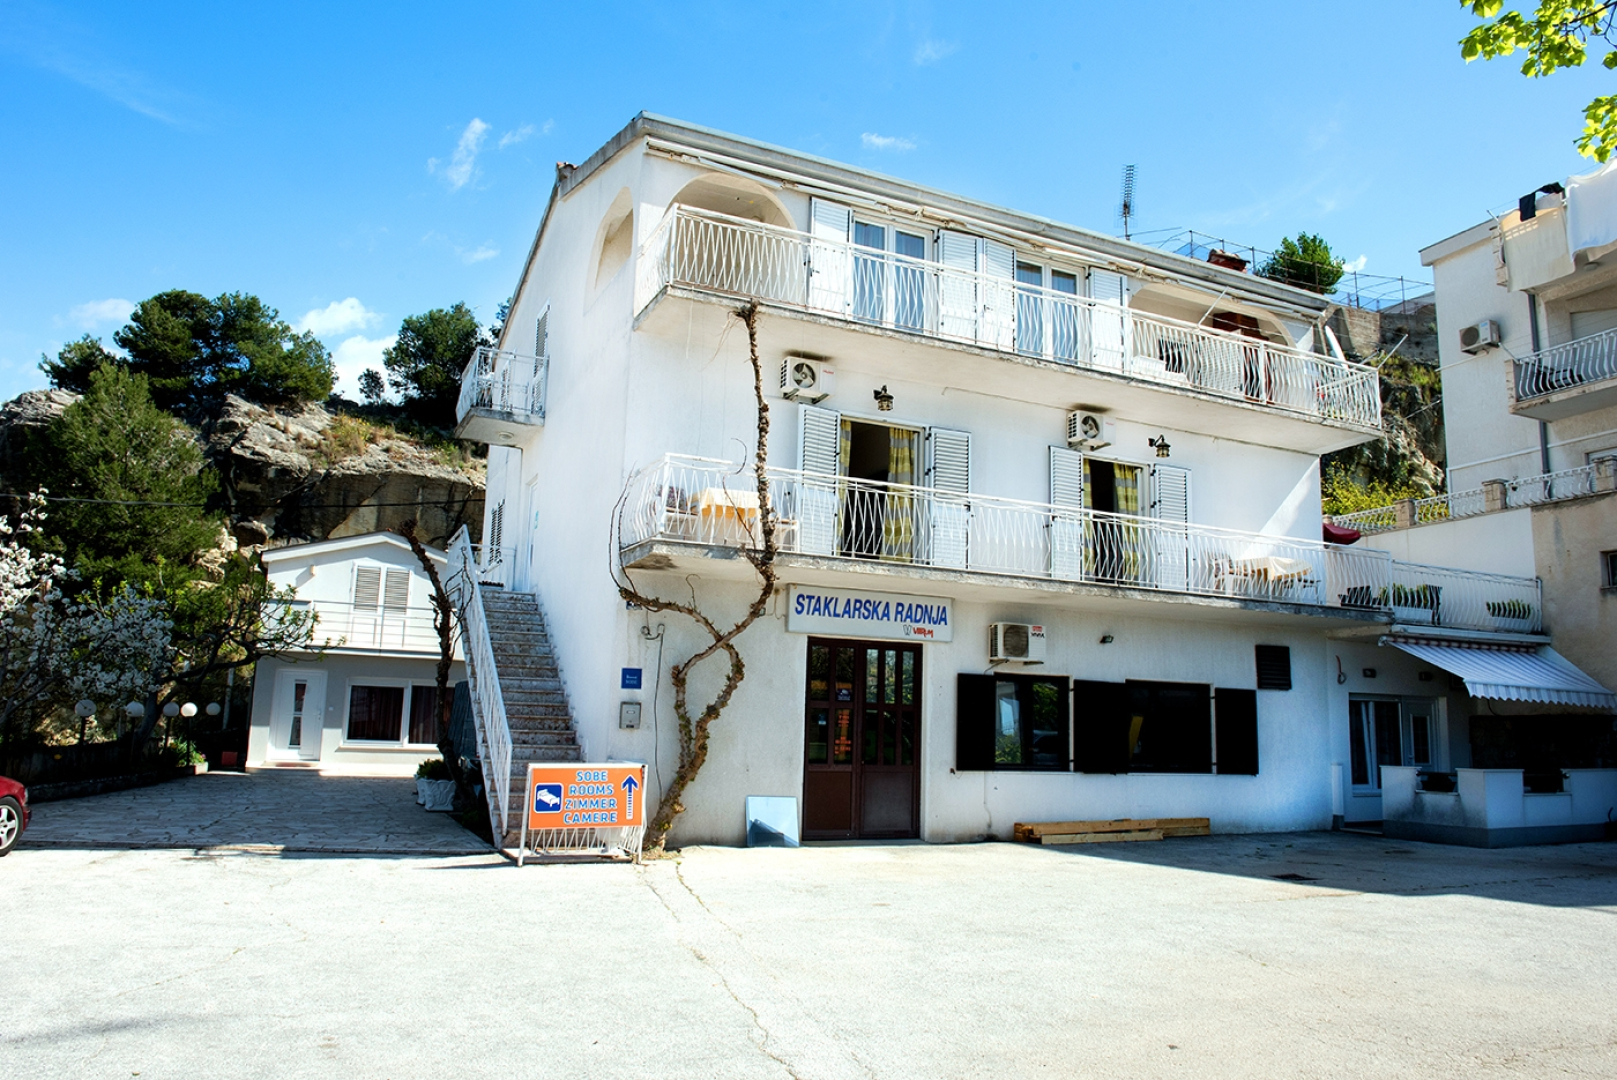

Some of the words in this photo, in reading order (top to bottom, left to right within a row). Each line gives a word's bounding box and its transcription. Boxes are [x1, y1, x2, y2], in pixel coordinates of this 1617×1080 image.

[795, 593, 890, 621] STAKLARSKA
[894, 602, 948, 626] RADNJA
[576, 770, 608, 782] SOBE
[568, 784, 614, 796] ROOMS
[565, 798, 617, 810] ZIMMER
[563, 812, 618, 824] CAMERE
